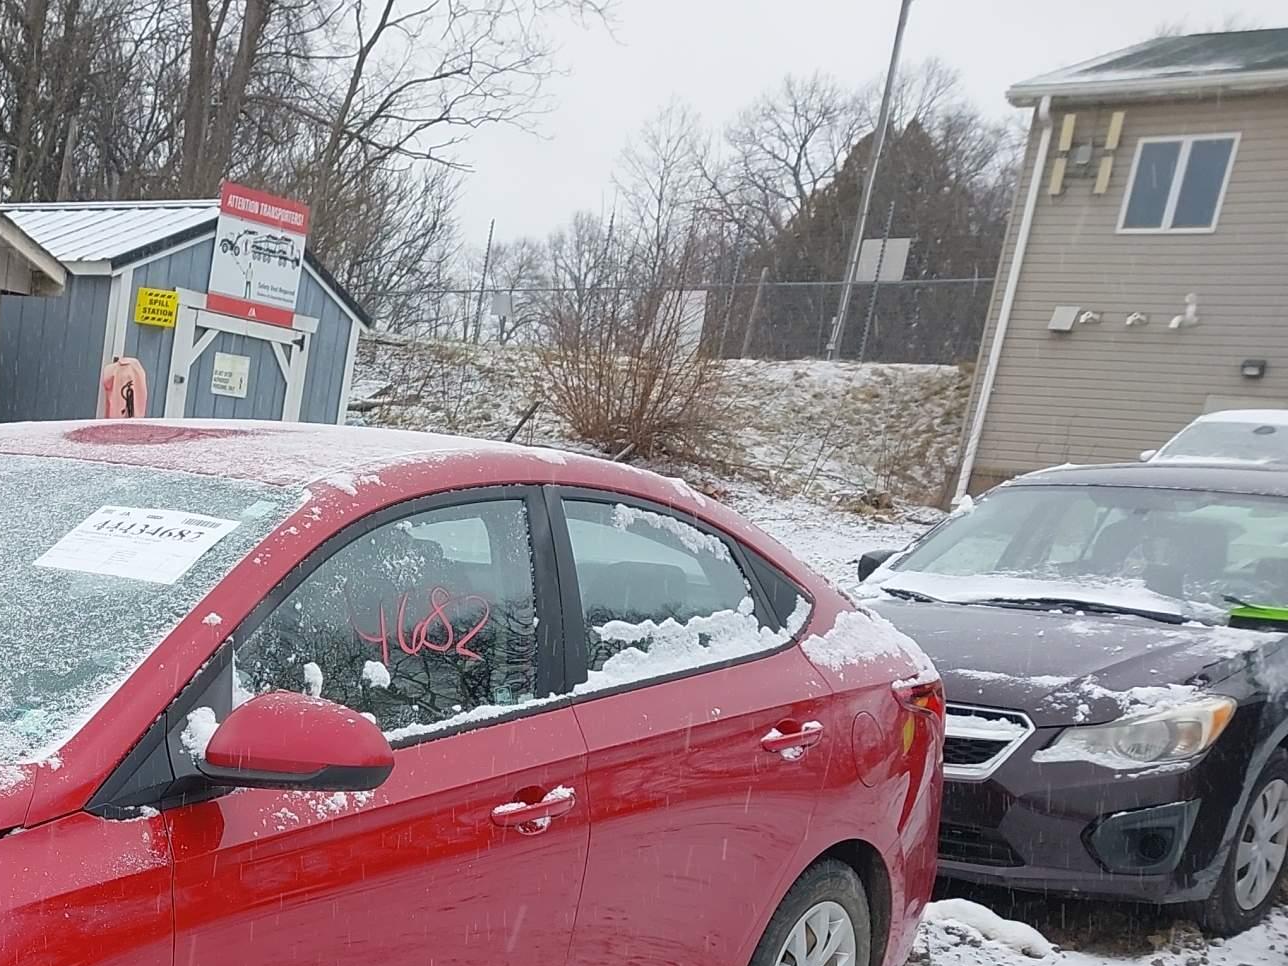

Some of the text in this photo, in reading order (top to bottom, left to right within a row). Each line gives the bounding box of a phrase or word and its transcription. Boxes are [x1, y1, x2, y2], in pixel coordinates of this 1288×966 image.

[227, 194, 260, 214] ATTENTION
[142, 307, 173, 317] STATION
[149, 299, 169, 308] SPILL
[93, 519, 205, 542] 44434682
[350, 585, 489, 667] 4682
